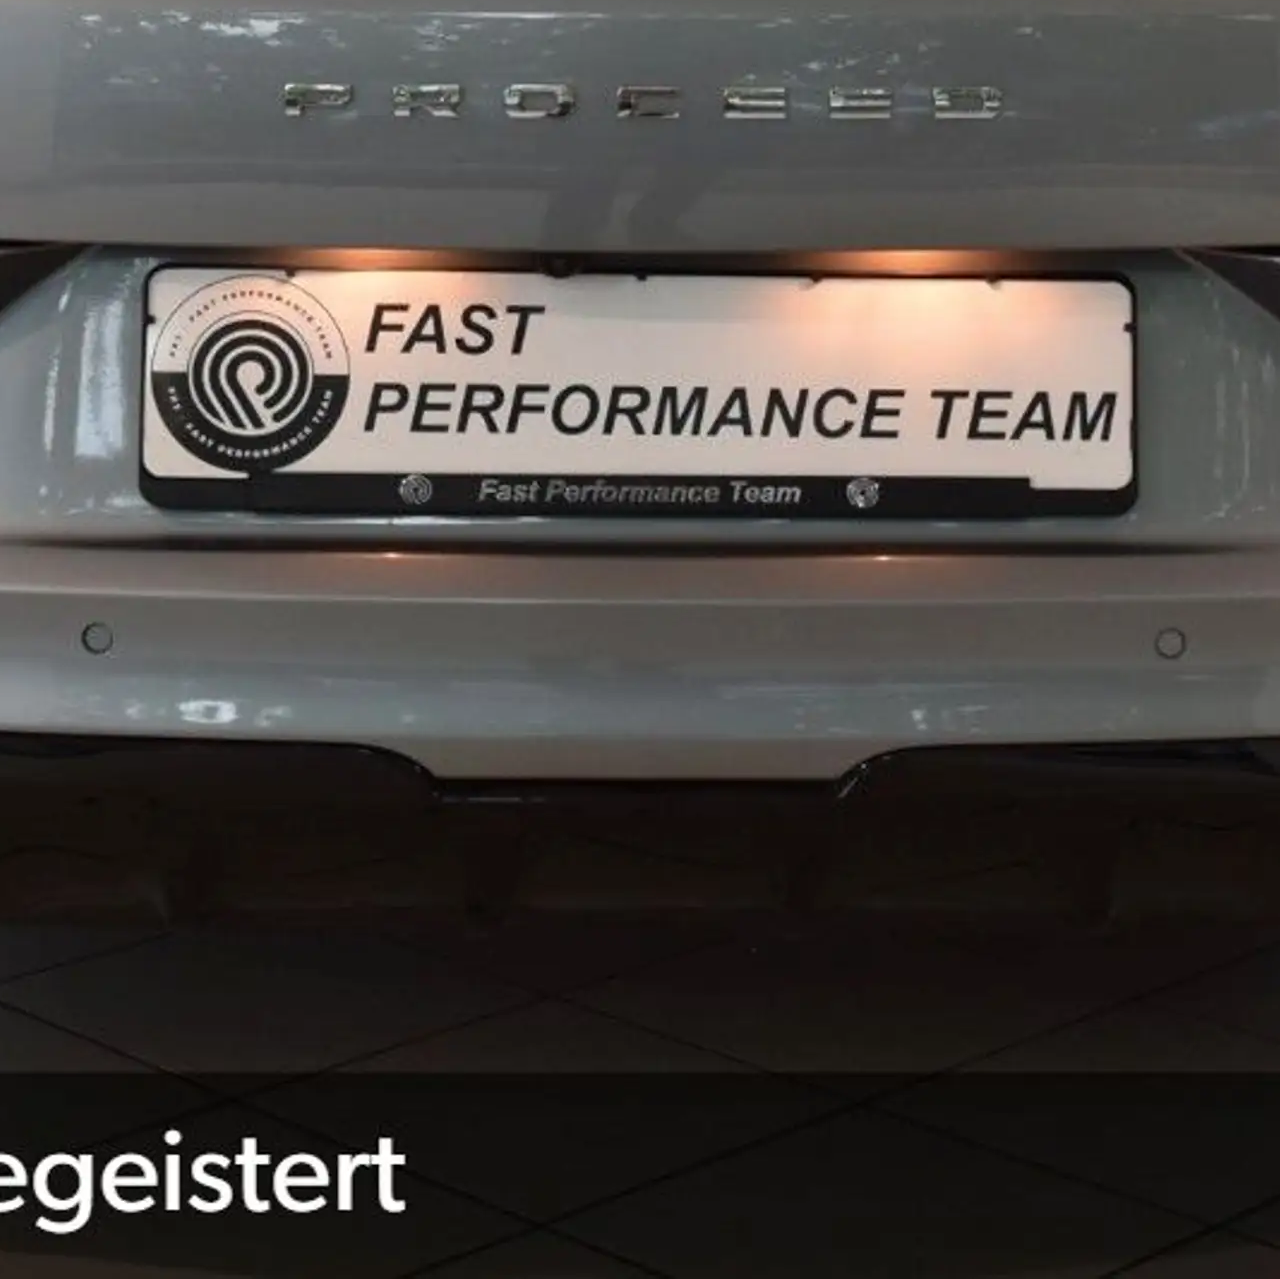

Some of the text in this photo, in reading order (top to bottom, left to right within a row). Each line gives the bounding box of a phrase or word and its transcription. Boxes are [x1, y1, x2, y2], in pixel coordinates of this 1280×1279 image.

[284, 83, 1003, 119] PROCEED
[365, 304, 546, 355] FAST
[364, 383, 1118, 442] PERFORMANCE TEAM
[478, 478, 802, 505] Fast Performance Team
